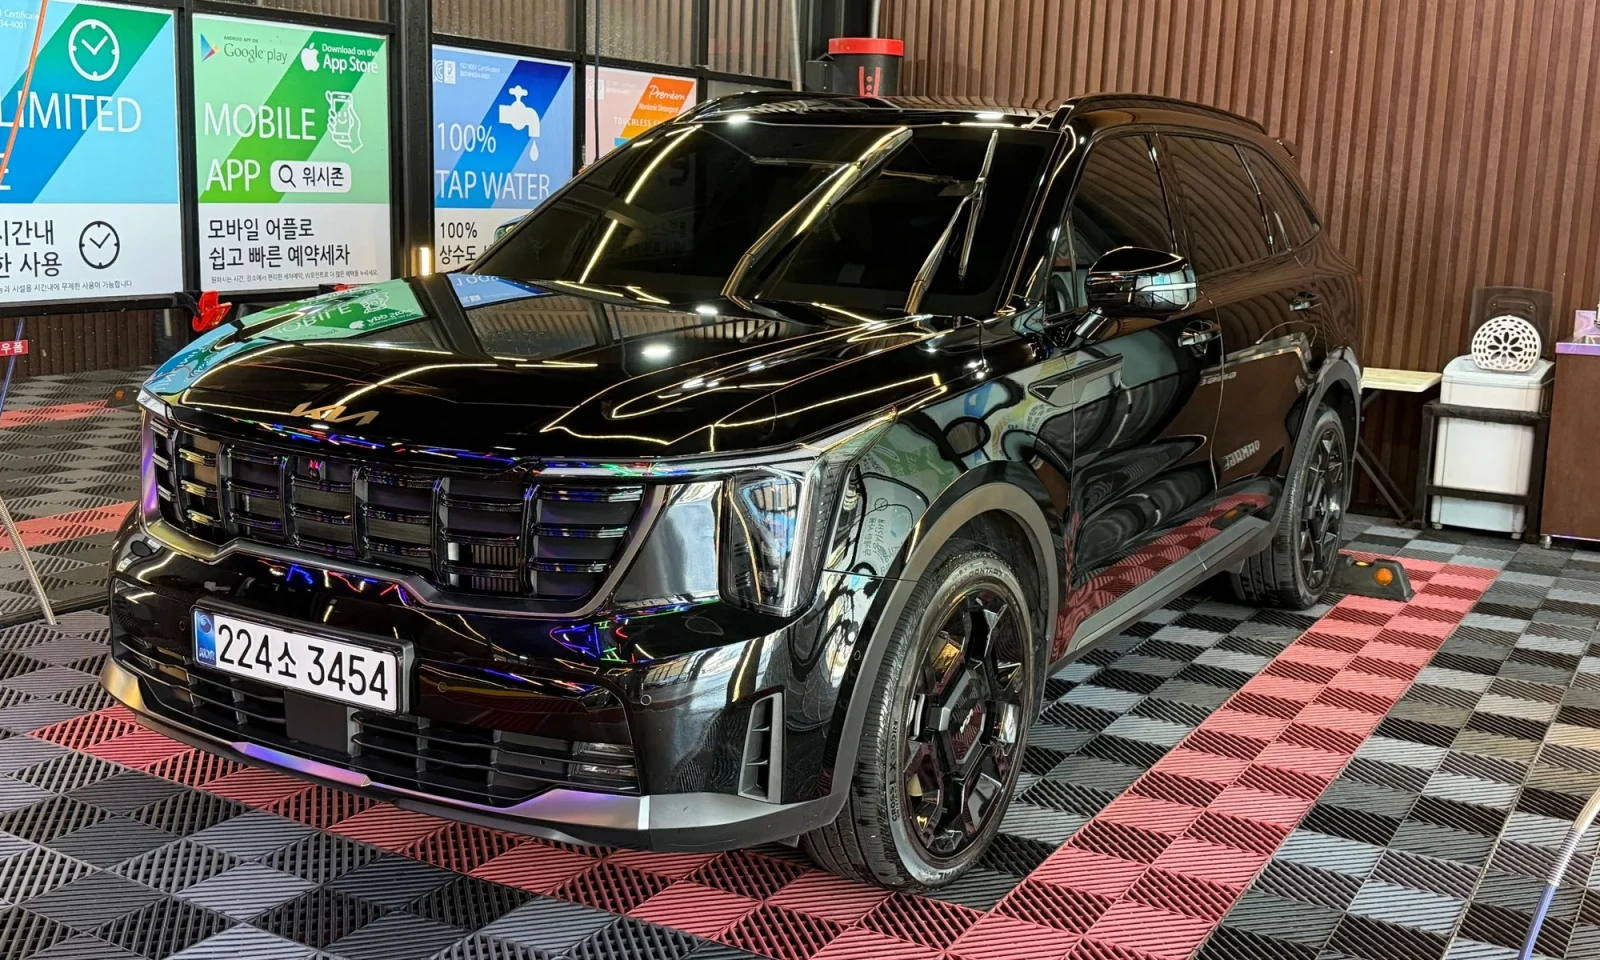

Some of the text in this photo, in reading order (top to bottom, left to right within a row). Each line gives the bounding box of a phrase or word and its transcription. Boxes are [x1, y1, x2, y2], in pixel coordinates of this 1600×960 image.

[223, 43, 288, 64] Google play
[322, 43, 356, 54] Download
[367, 47, 378, 57] the
[322, 55, 379, 74] App Store
[648, 85, 685, 100] Premium
[204, 102, 317, 141] MOBILE
[613, 116, 652, 127] TOUCHLESS
[437, 122, 497, 153] 100%
[206, 158, 261, 192] APP
[302, 166, 345, 187] 워시존
[435, 170, 550, 200] TAP WATER
[207, 217, 315, 241] 모바일 어플로
[440, 221, 478, 239] 100%
[19, 251, 63, 278] 사용
[208, 243, 351, 271] 쉽고 빠른 예약세차
[439, 245, 476, 265] 상수도
[12, 284, 32, 294] 시설을
[34, 282, 60, 292] 시간내에
[82, 281, 101, 290] 사용이
[217, 623, 389, 702] 224소 3454
